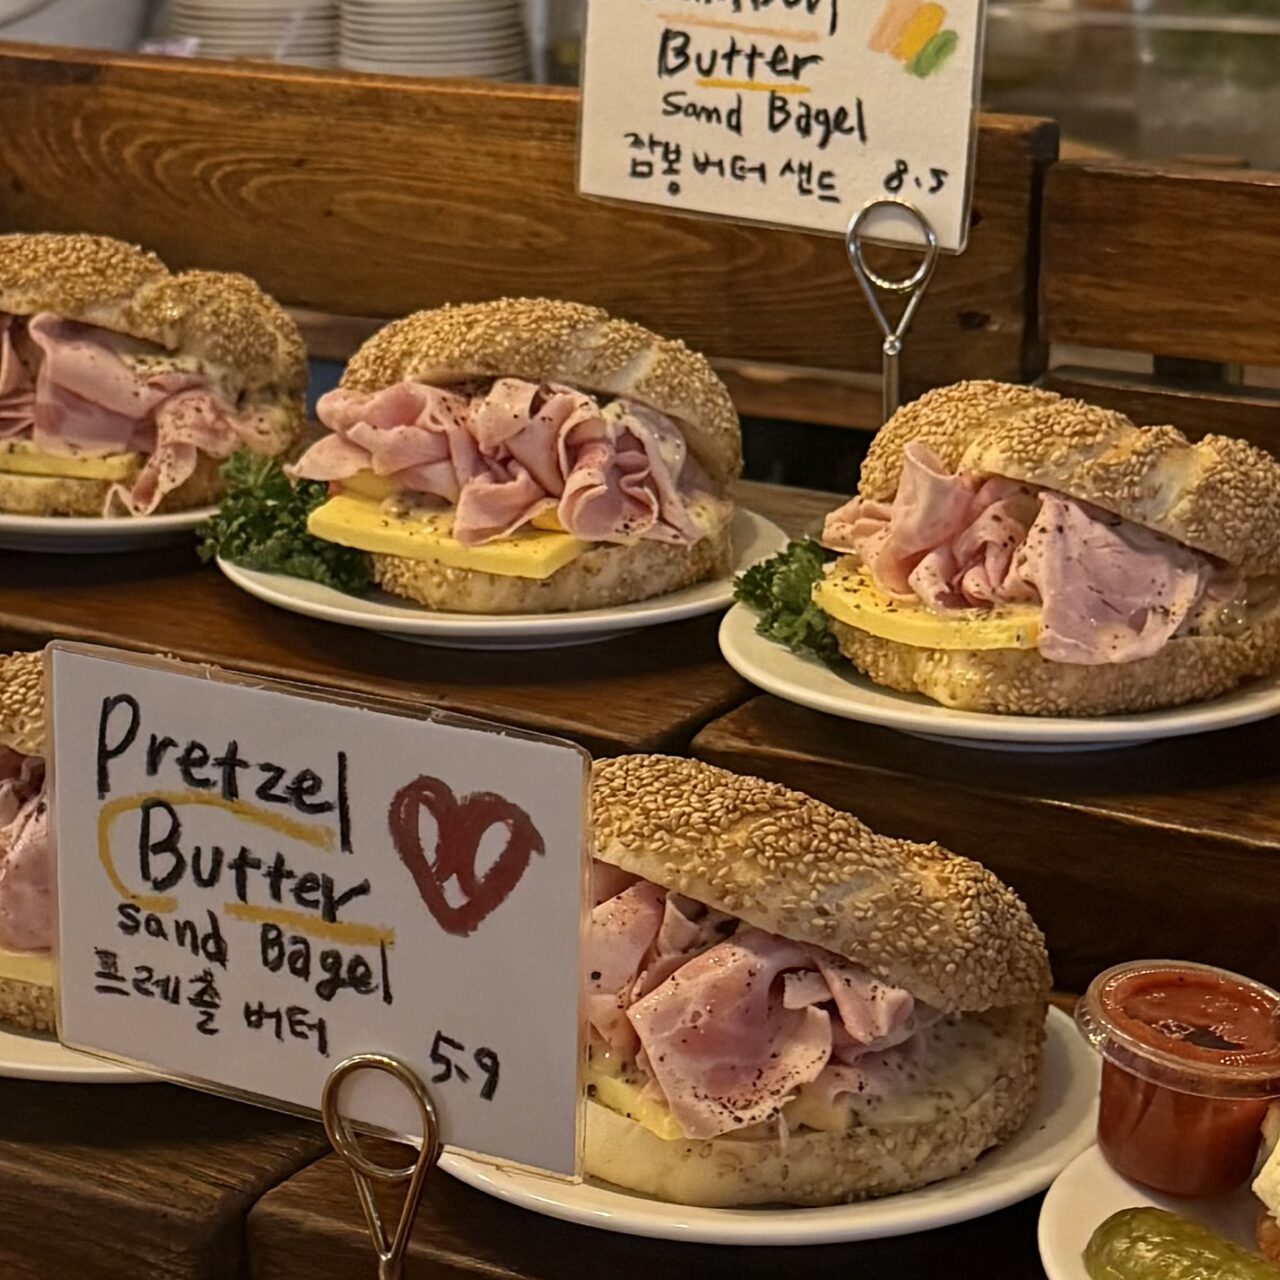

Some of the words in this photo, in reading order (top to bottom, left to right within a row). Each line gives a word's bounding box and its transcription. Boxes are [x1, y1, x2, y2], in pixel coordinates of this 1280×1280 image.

[658, 27, 824, 80] Butter
[767, 90, 869, 150] Bagel
[624, 132, 682, 197] 잠봉
[691, 151, 767, 185] 버터
[779, 158, 841, 204] 샌드
[882, 158, 950, 195] 8.5
[97, 693, 354, 855] Pretzel
[139, 798, 372, 923] Butter
[260, 921, 393, 1005] Bagel
[243, 1000, 332, 1058] 버터
[428, 1029, 501, 1103] 5.9
